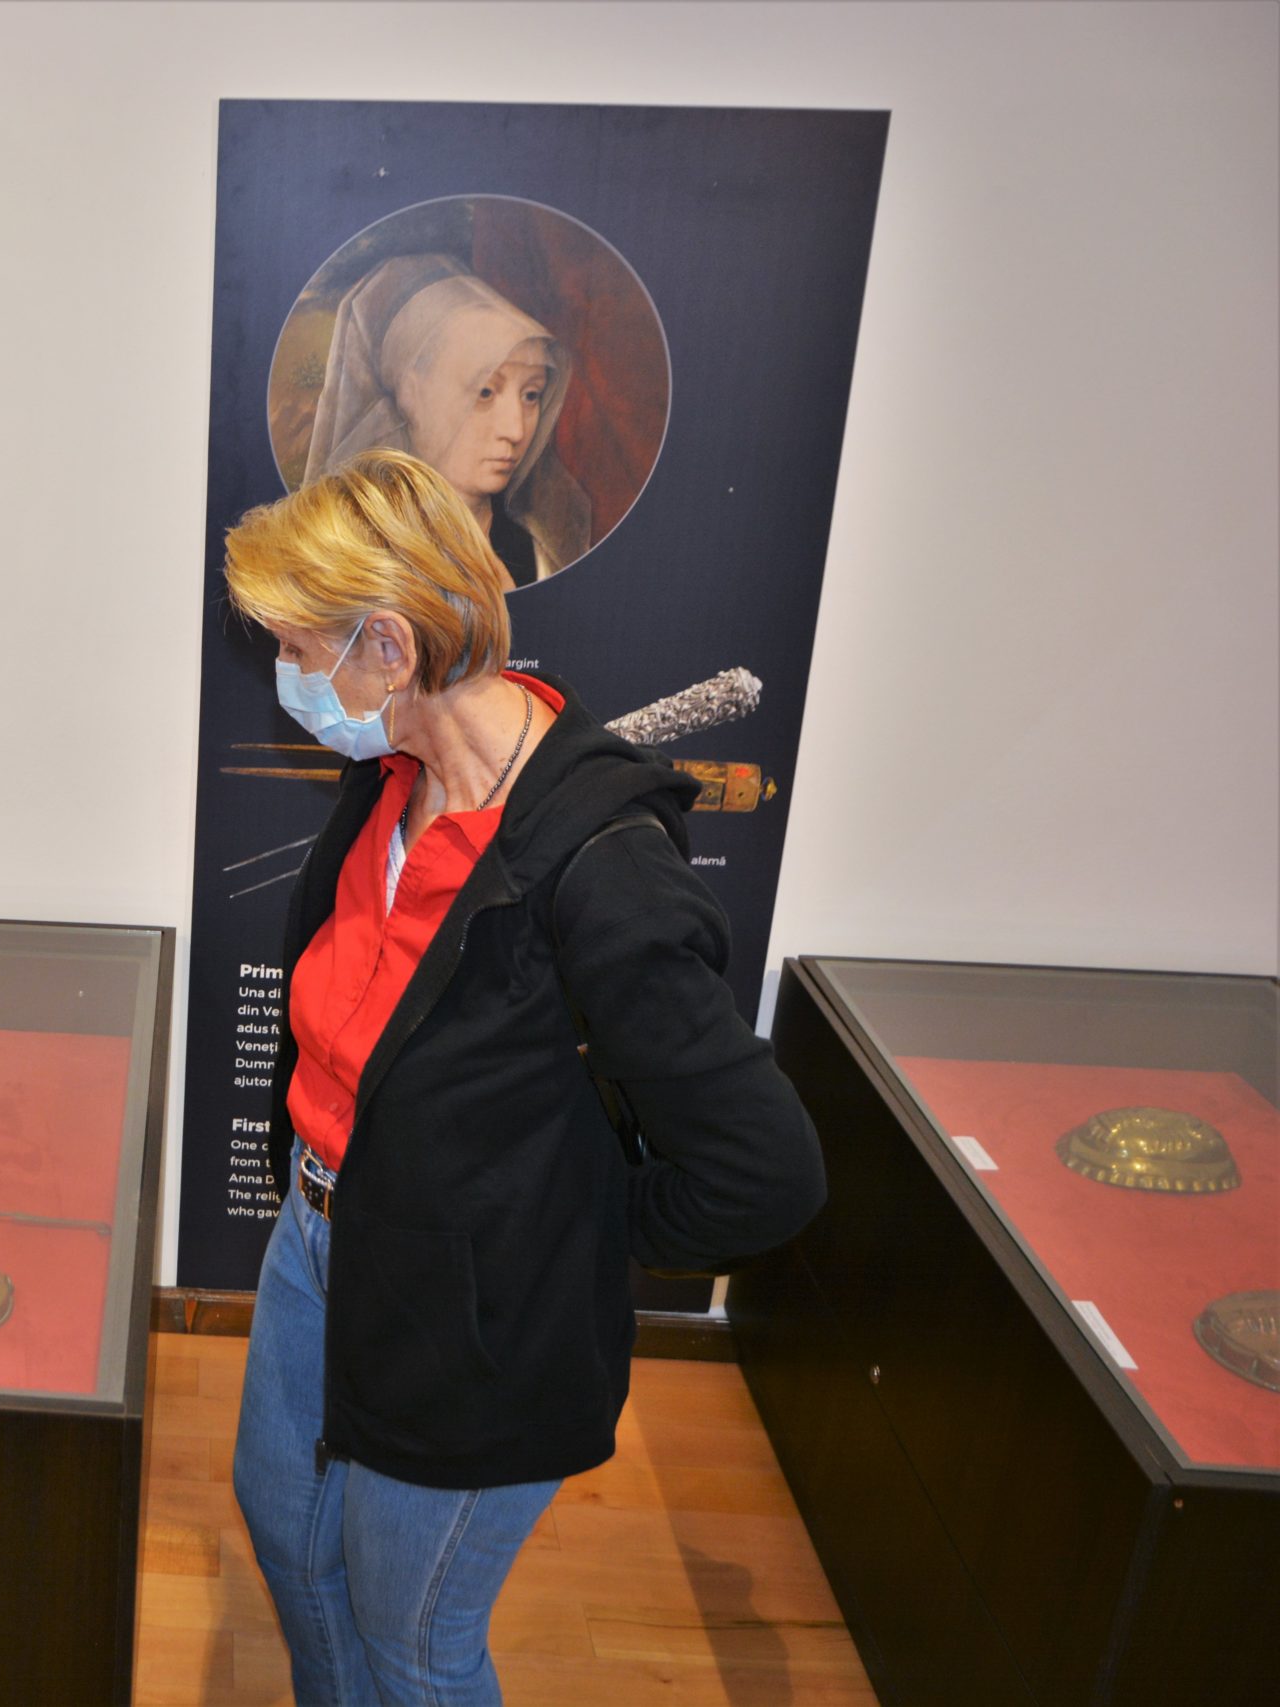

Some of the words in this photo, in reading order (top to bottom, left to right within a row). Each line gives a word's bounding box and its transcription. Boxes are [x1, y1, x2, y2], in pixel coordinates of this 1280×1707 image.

[239, 987, 265, 998] Una
[237, 1004, 259, 1016] din
[262, 1006, 280, 1017] Ve
[237, 1023, 268, 1034] adus
[232, 1118, 270, 1132] First
[230, 1139, 257, 1150] One
[230, 1156, 260, 1167] from
[229, 1173, 262, 1184] Anna
[228, 1189, 252, 1200] The
[227, 1206, 255, 1216] who
